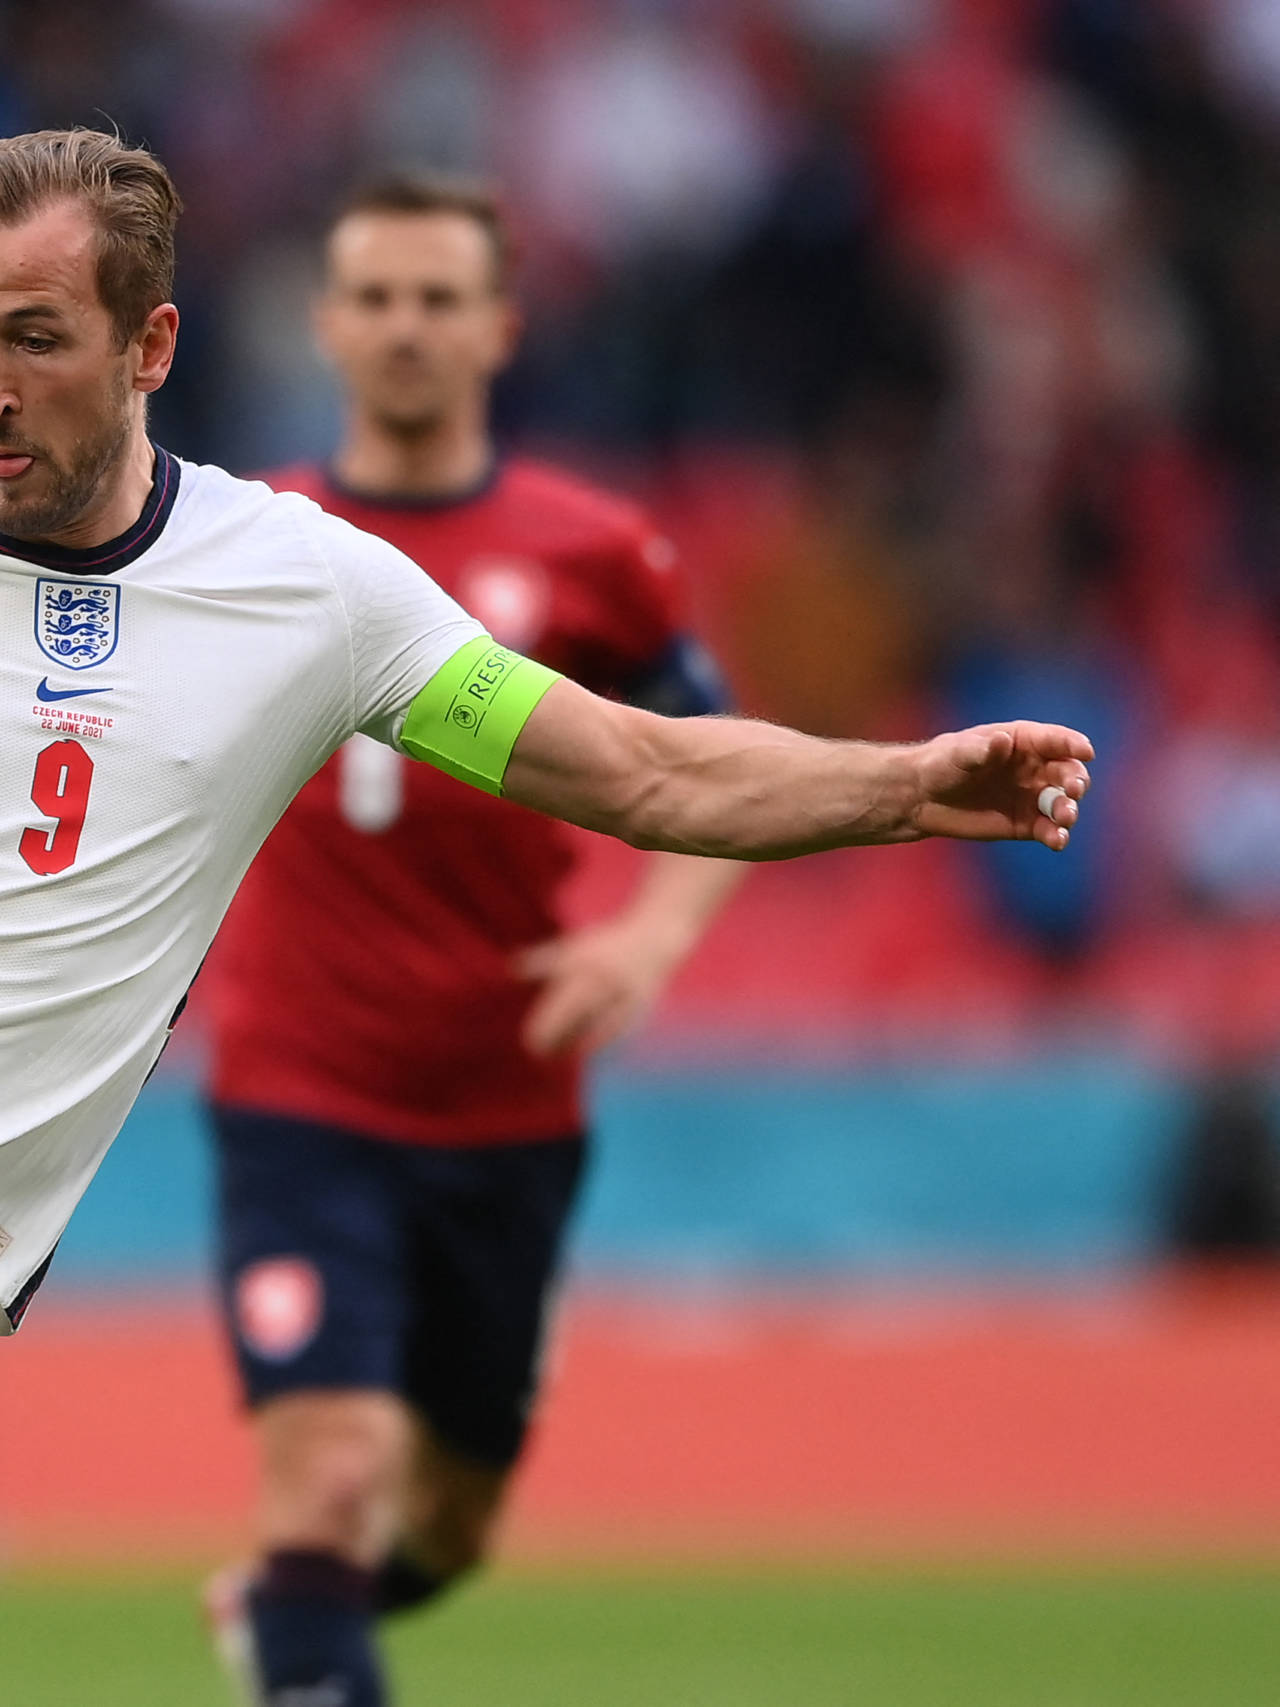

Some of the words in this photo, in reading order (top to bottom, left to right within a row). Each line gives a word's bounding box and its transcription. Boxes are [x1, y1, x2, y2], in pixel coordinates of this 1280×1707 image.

[467, 649, 519, 701] RESP
[32, 705, 64, 719] CZECH
[66, 711, 114, 728] REPUBLIC
[41, 718, 54, 730] 22
[55, 720, 81, 735] JUNE
[82, 725, 104, 739] 2021
[18, 738, 95, 876] 9
